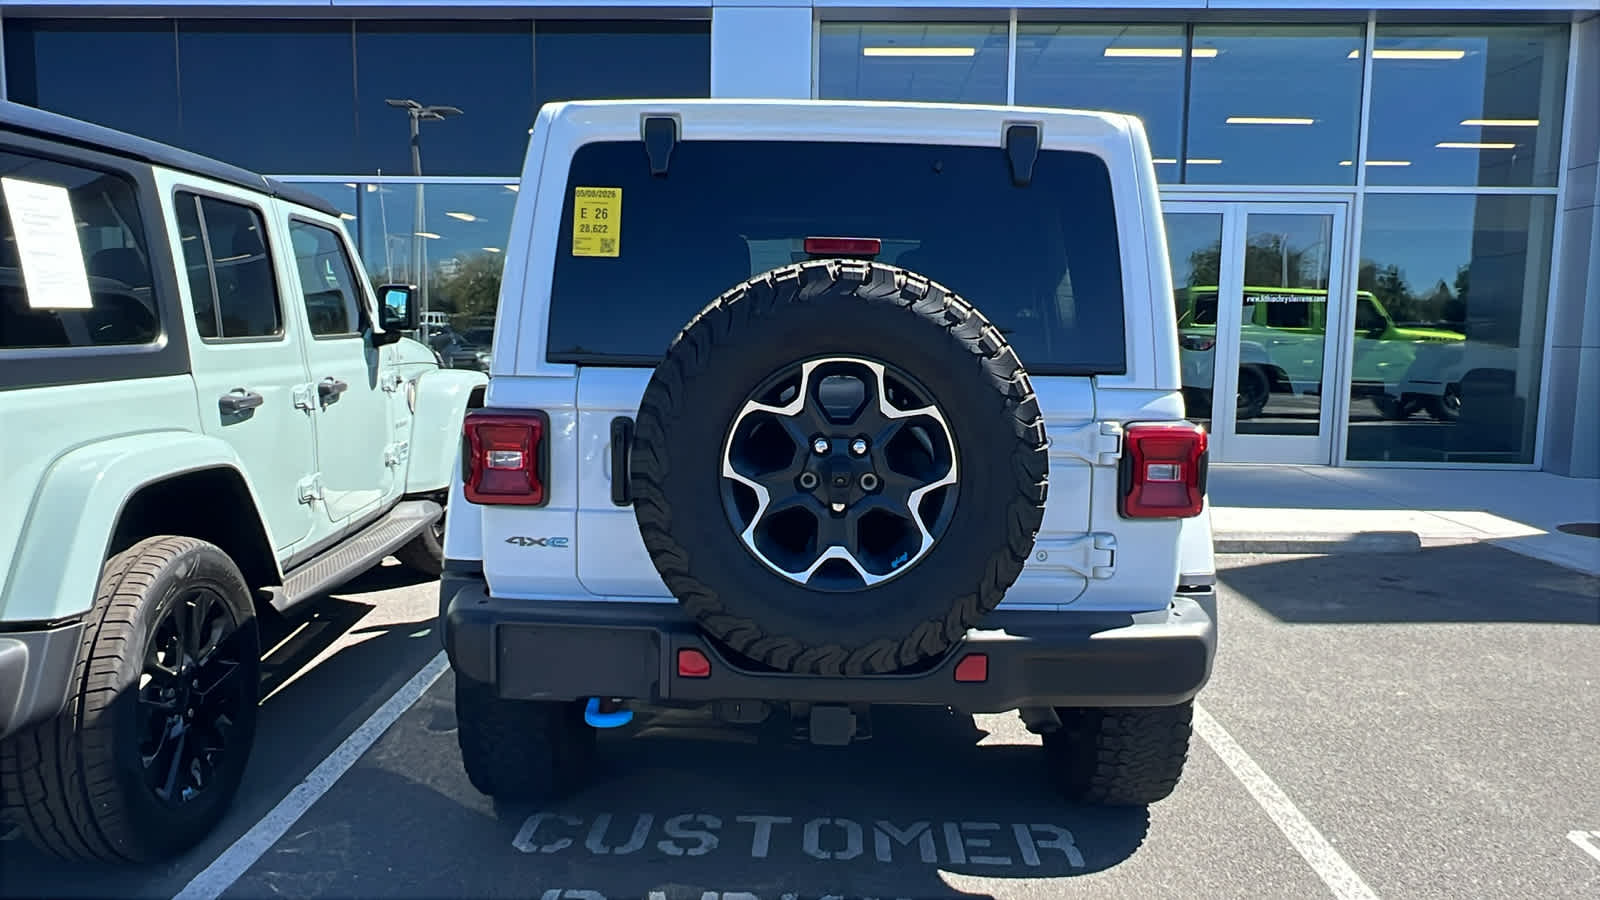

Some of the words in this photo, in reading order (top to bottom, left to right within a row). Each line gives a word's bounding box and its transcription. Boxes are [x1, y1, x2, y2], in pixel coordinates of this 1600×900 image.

[581, 207, 588, 219] E
[595, 207, 608, 220] 26
[511, 812, 1086, 868] CUSTOMER
